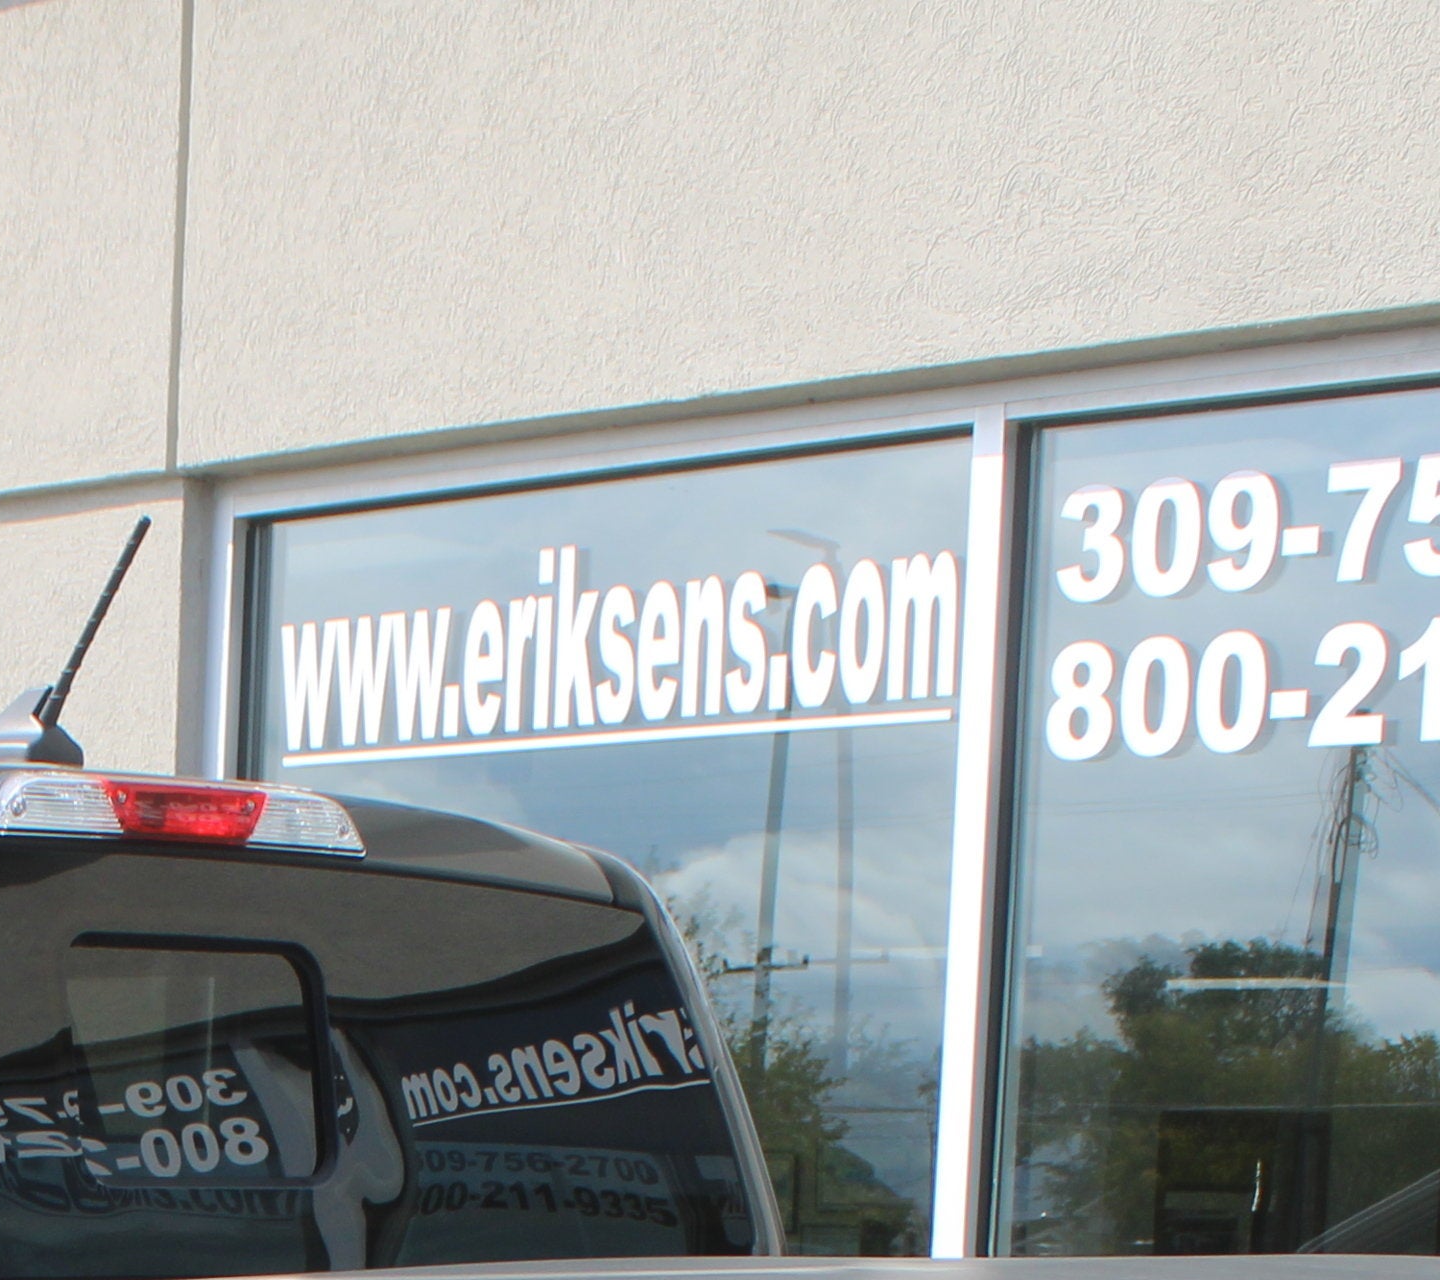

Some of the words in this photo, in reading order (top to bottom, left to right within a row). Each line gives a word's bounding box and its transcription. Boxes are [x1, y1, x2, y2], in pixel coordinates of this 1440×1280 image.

[280, 546, 958, 745] www.eriksens.com
[419, 1149, 661, 1186] 09-756-2700
[419, 1180, 678, 1228] 00-211-9335
